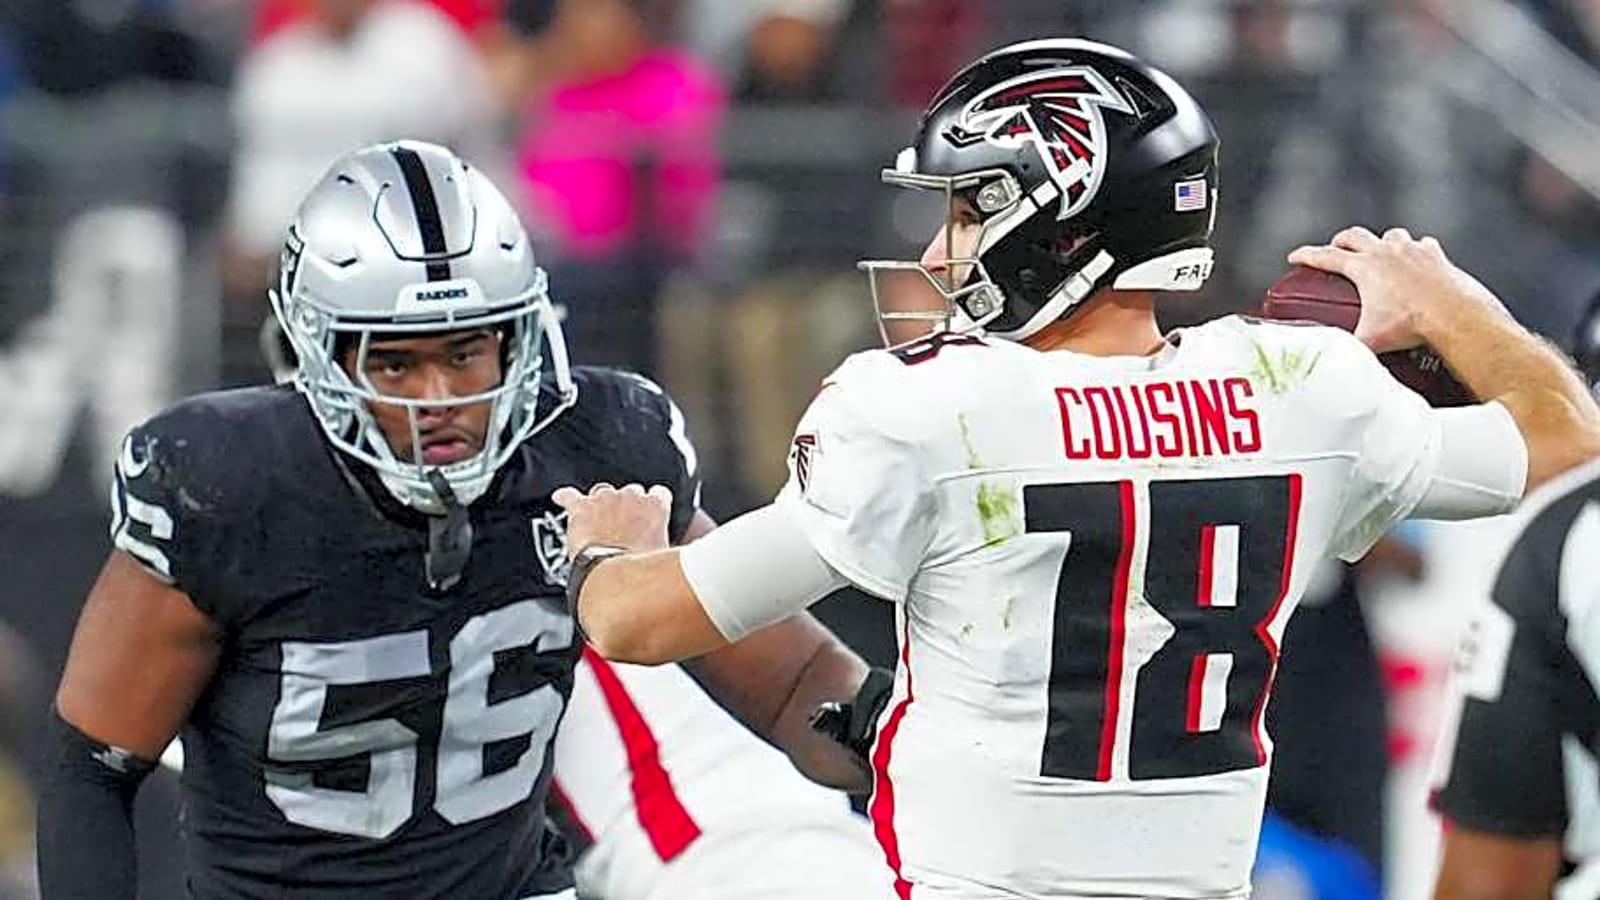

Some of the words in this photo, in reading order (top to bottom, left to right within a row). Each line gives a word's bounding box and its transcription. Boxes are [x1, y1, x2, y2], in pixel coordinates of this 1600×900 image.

[416, 287, 468, 301] RAIDERS
[1054, 377, 1262, 459] COUSINS
[1023, 473, 1302, 782] 18
[263, 598, 575, 839] 56
